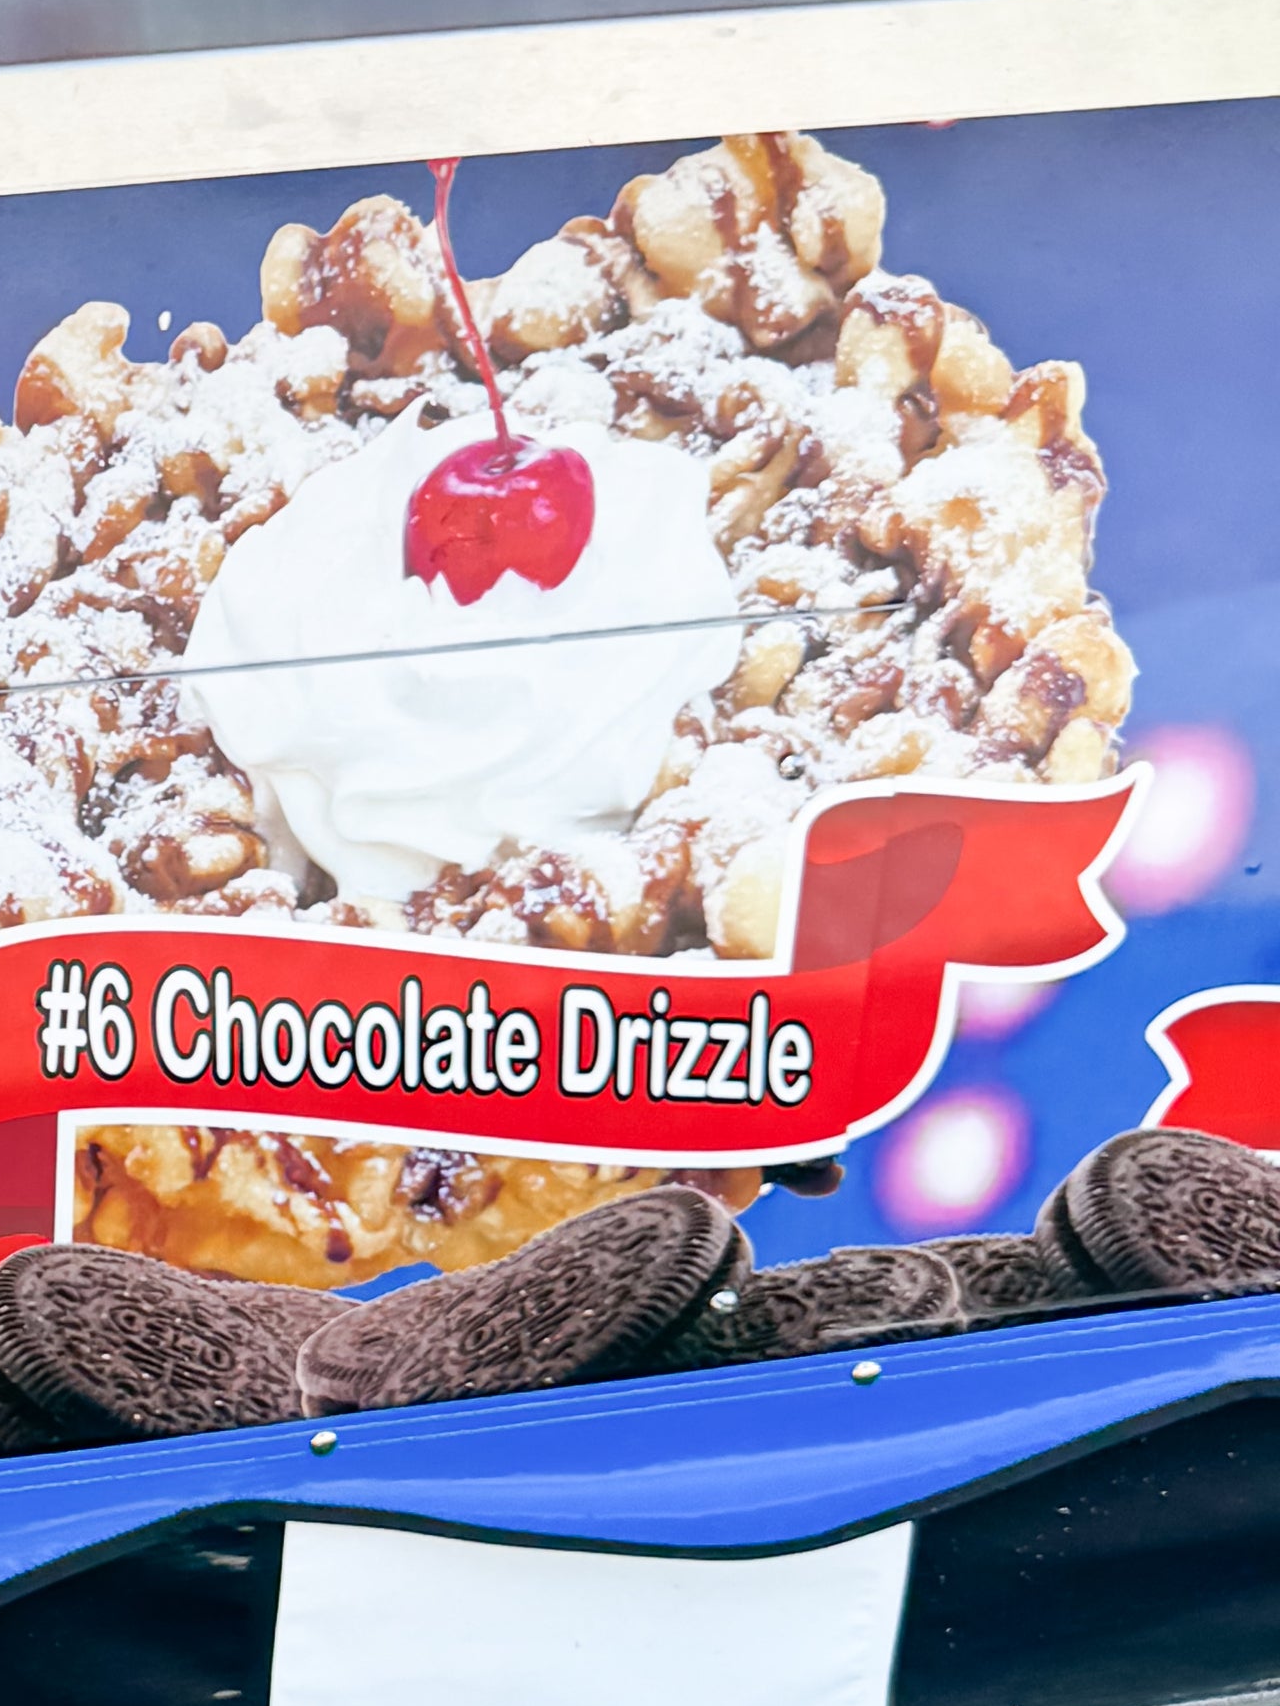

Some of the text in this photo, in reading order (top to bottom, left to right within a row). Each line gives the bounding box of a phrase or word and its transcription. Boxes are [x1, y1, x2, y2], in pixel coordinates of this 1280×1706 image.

[37, 959, 814, 1107] #6 Chocolate Drizzle
